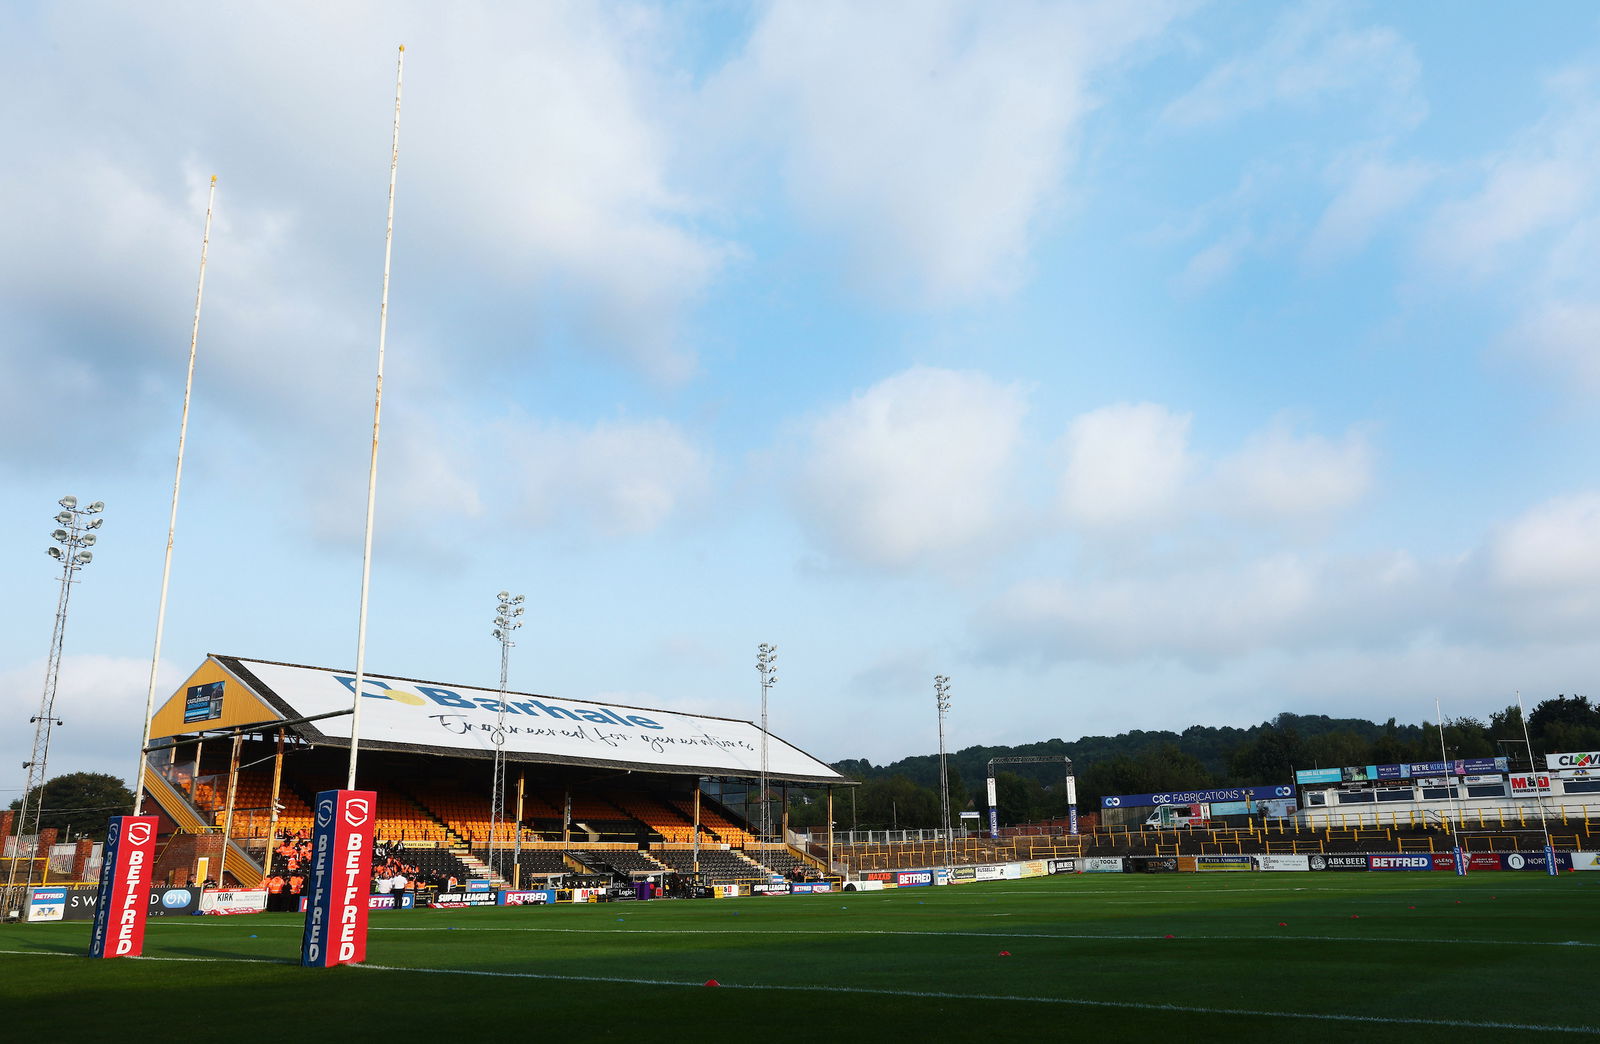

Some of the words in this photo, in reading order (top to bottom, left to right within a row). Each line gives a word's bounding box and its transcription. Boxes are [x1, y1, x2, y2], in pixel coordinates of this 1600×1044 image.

[414, 685, 664, 730] Barhale
[594, 727, 633, 747] for
[1152, 794, 1171, 804] C&C
[1172, 789, 1239, 803] FABRICATIONS
[1328, 857, 1345, 865] ABK
[1345, 857, 1367, 865] BEER
[1372, 857, 1429, 868] BETFRED
[867, 872, 892, 881] MAXXIS
[899, 873, 931, 885] BETFRED
[93, 851, 113, 955] BETFRED
[116, 850, 145, 955] BETFRED
[217, 892, 234, 902] KIRK
[309, 834, 328, 962] BETFRED
[339, 833, 363, 961] BETFRED
[438, 893, 462, 903] SUPER
[462, 892, 489, 902] LEAGUE
[506, 892, 548, 903] BETFRED
